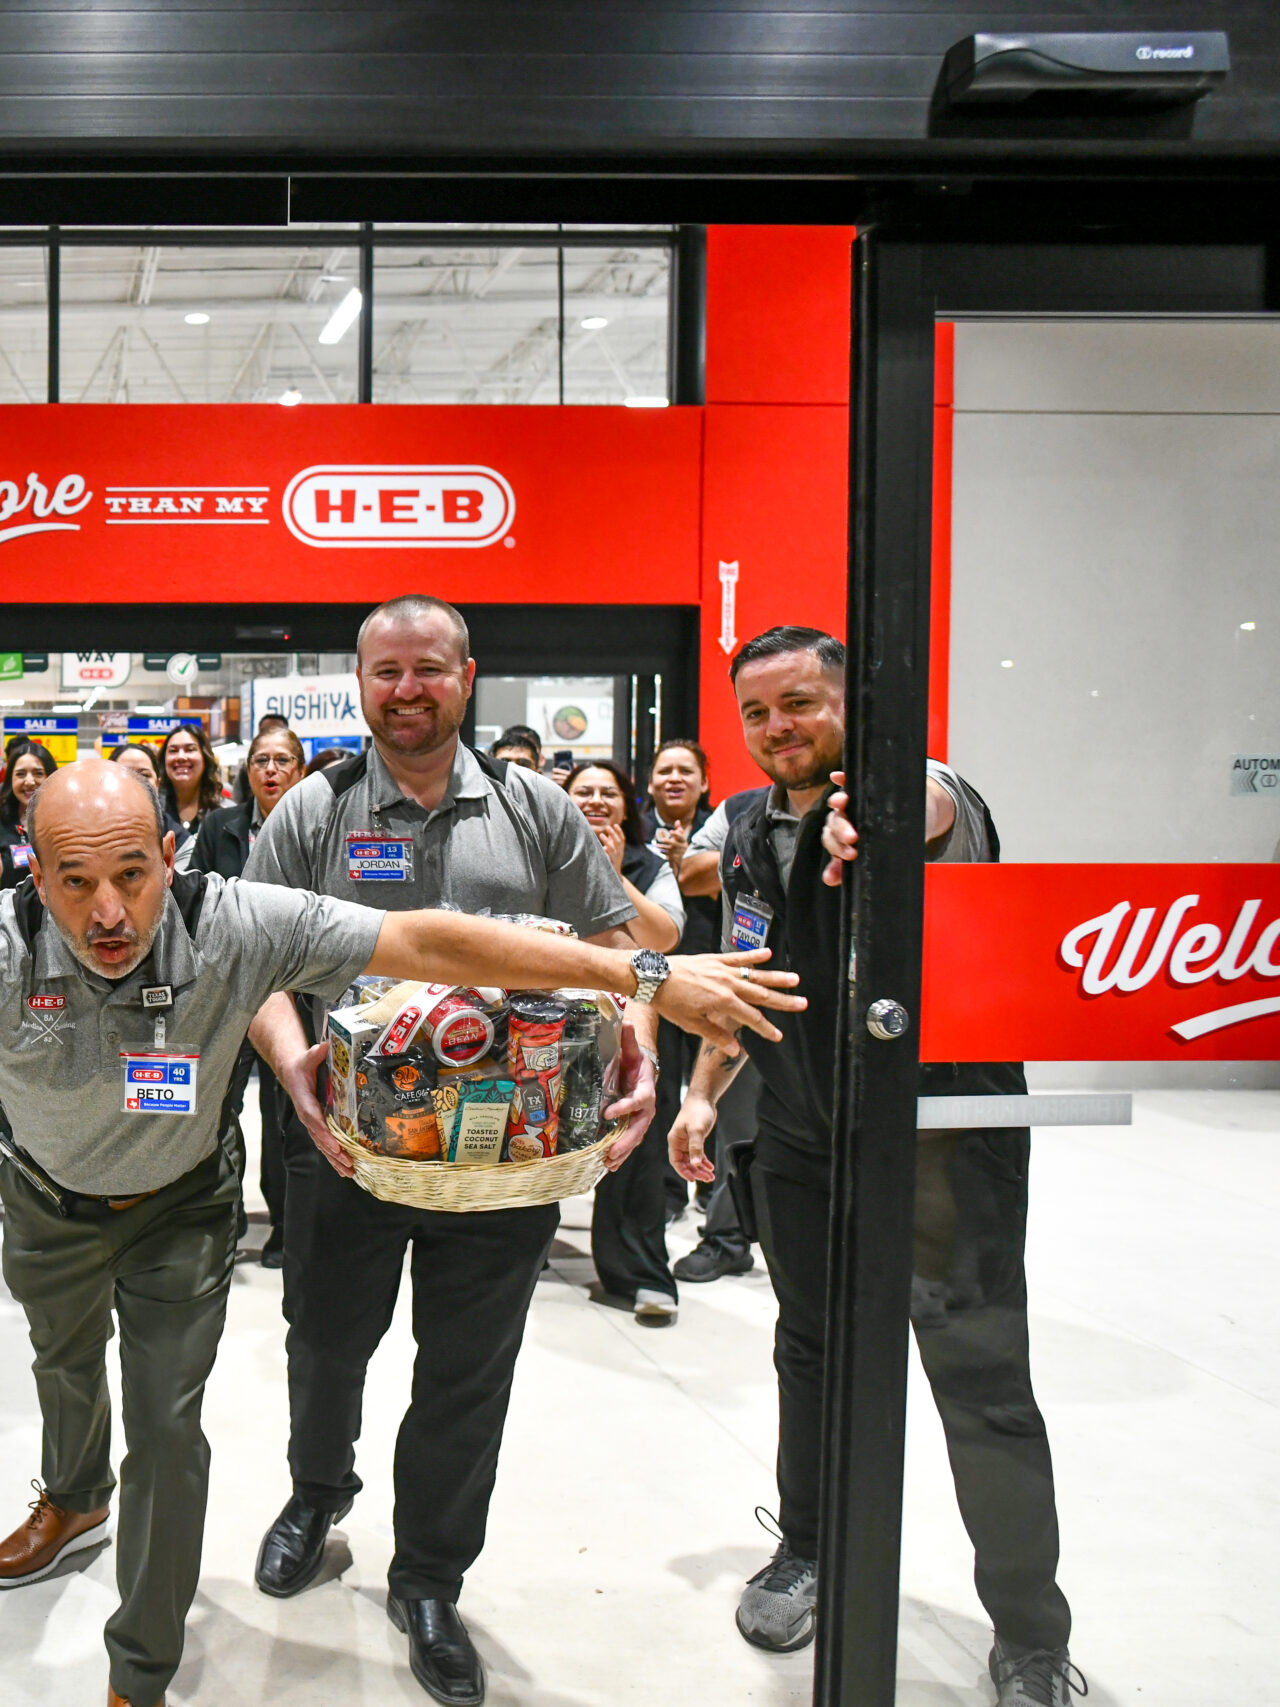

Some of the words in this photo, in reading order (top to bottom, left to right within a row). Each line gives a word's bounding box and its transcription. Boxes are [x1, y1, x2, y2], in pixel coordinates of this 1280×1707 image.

[1152, 46, 1194, 58] record
[105, 497, 205, 514] THAN
[215, 497, 268, 514] MY
[313, 488, 485, 524] H-E-B
[24, 719, 57, 729] SALE!
[1233, 758, 1280, 771] AUTOM
[357, 860, 401, 869] JORDAN
[736, 929, 761, 948] TAYLOR
[32, 998, 64, 1007] H-E-B
[135, 1071, 161, 1079] H-E-B
[172, 1067, 186, 1076] 40
[137, 1088, 174, 1100] BETO
